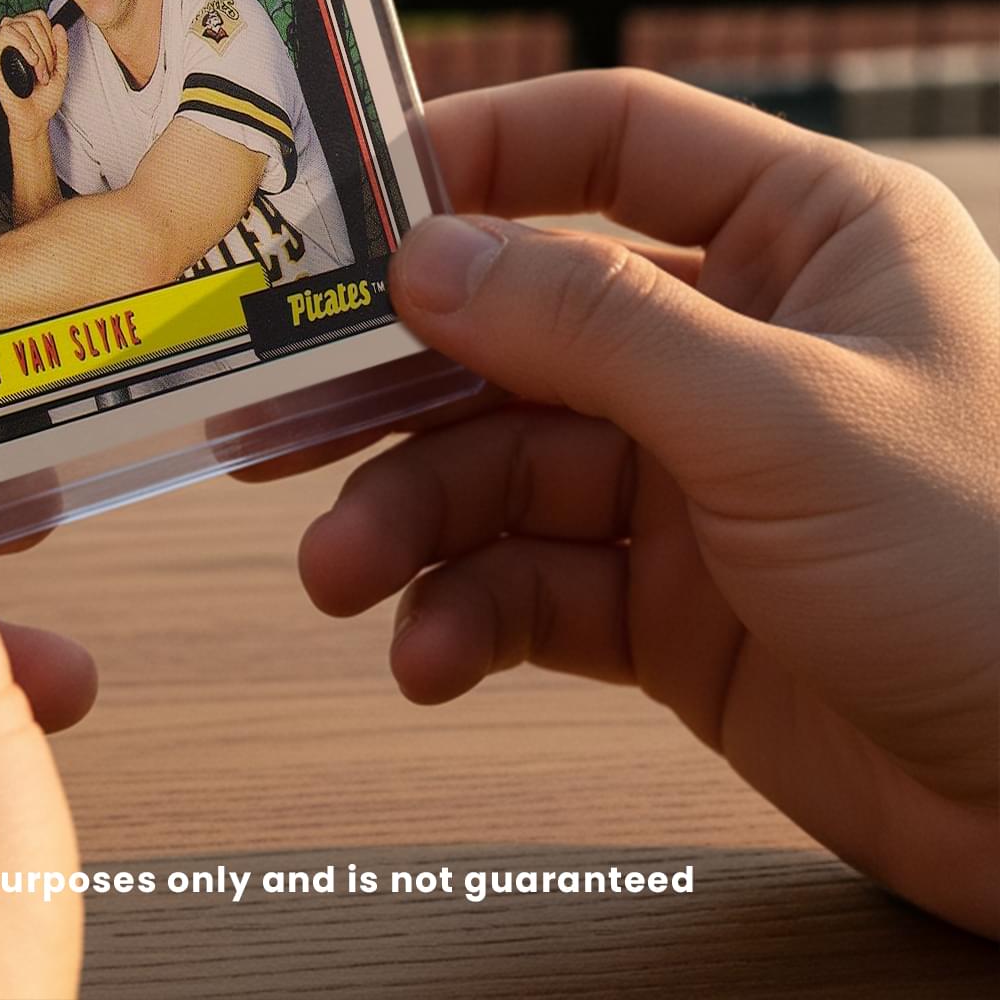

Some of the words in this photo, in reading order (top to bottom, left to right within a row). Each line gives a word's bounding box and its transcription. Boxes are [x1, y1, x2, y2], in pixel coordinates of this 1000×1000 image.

[286, 279, 372, 327] Pirates
[13, 331, 61, 377] VAN
[69, 310, 142, 362] SLYKE
